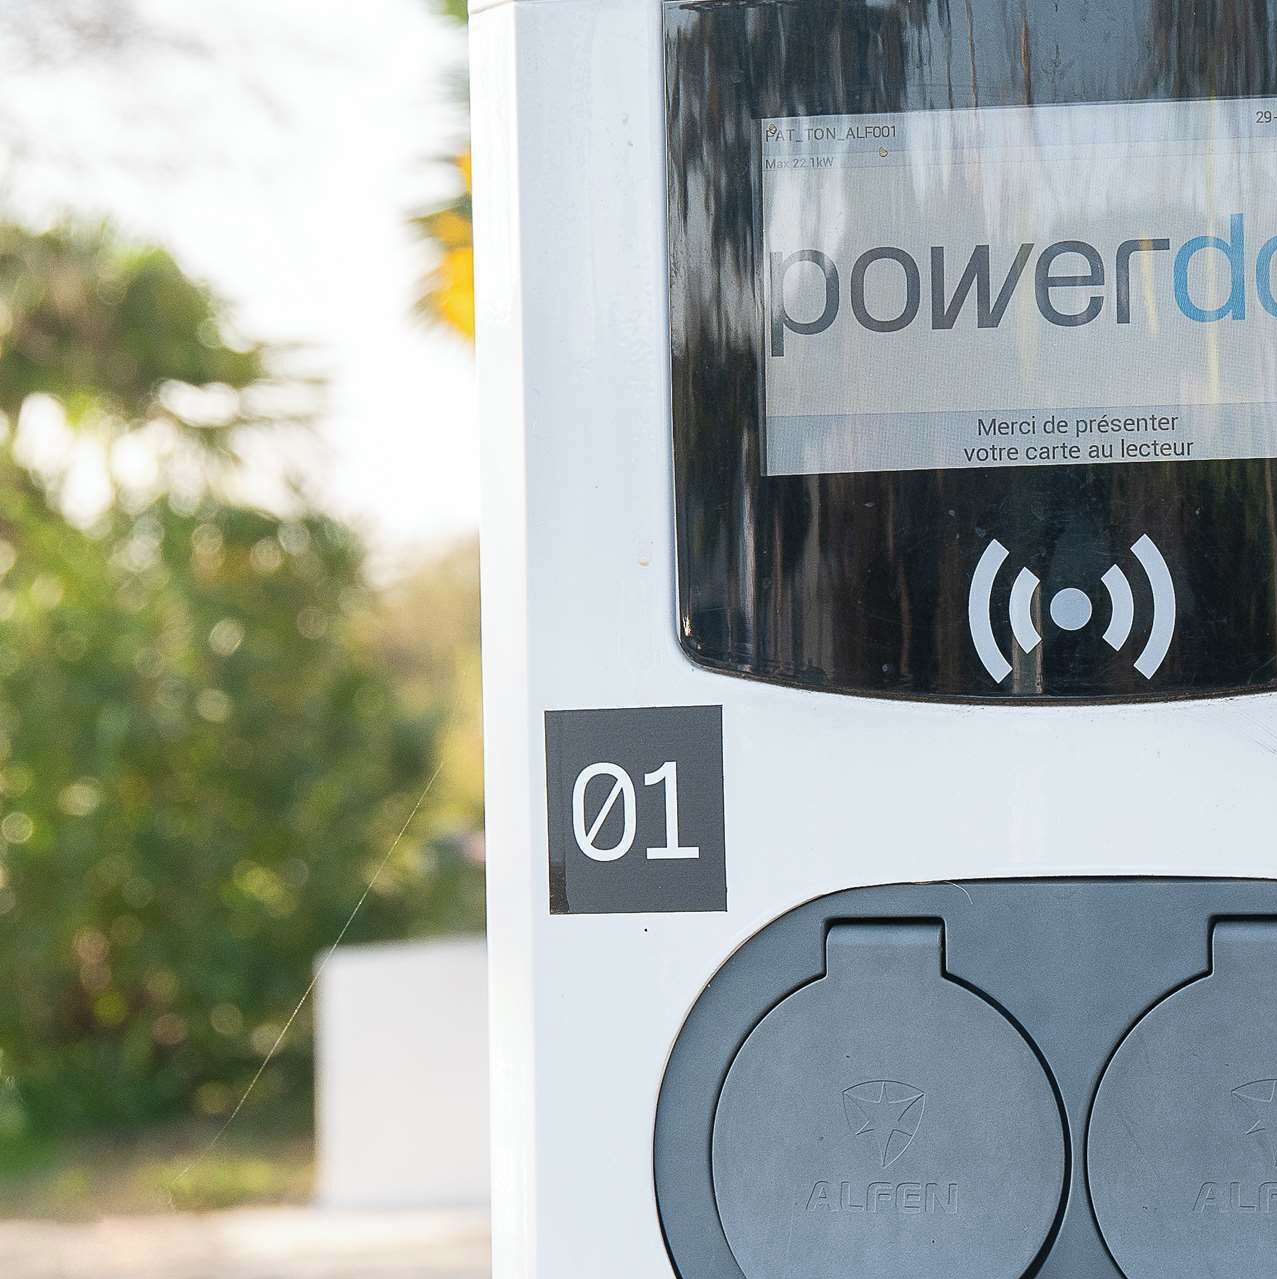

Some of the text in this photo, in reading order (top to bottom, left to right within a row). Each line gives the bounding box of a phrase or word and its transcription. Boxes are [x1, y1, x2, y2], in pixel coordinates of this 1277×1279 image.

[978, 414, 1179, 437] Merci de présenter
[964, 439, 1194, 462] votre carte au lecteur
[572, 761, 700, 862] 01
[805, 1181, 960, 1215] ALFEN
